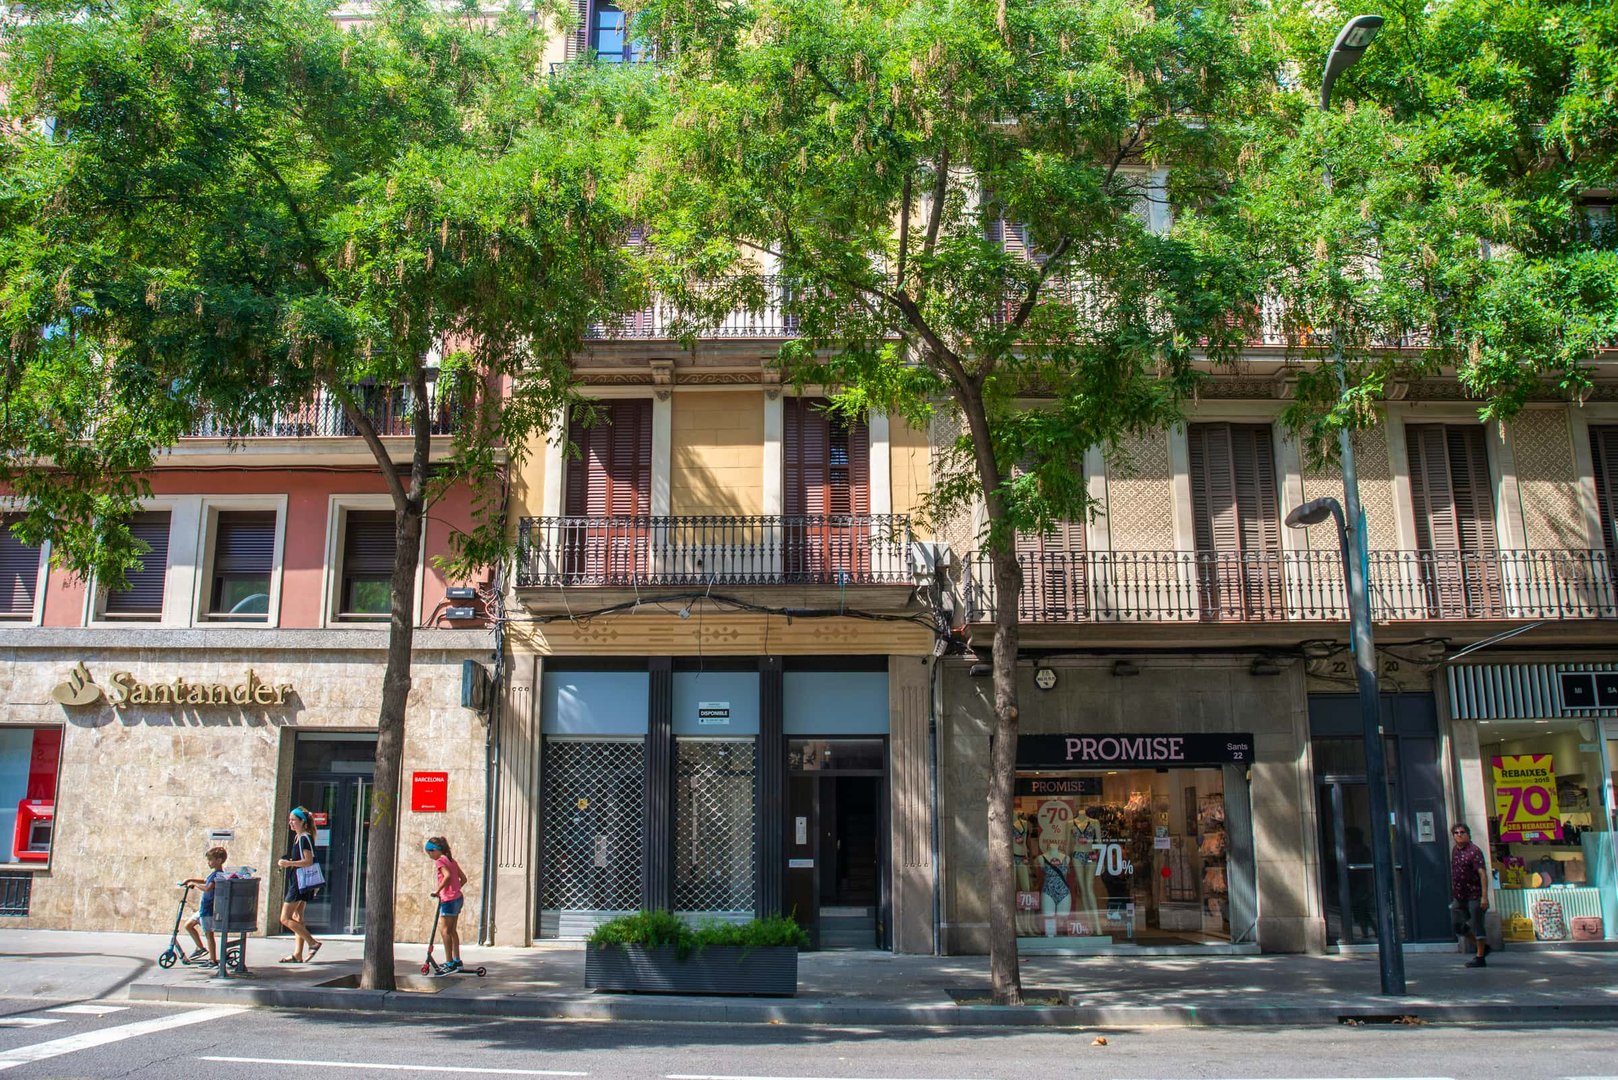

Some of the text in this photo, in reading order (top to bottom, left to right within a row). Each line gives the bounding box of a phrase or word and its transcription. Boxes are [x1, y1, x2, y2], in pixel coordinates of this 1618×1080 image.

[1332, 661, 1347, 672] 22
[1384, 660, 1399, 672] 20
[109, 668, 294, 708] Santander
[1065, 738, 1184, 760] PROMISE
[1226, 742, 1248, 750] Sants
[1233, 752, 1244, 760] 22
[1501, 768, 1548, 778] REBAIXES
[1032, 781, 1085, 793] PROMISE
